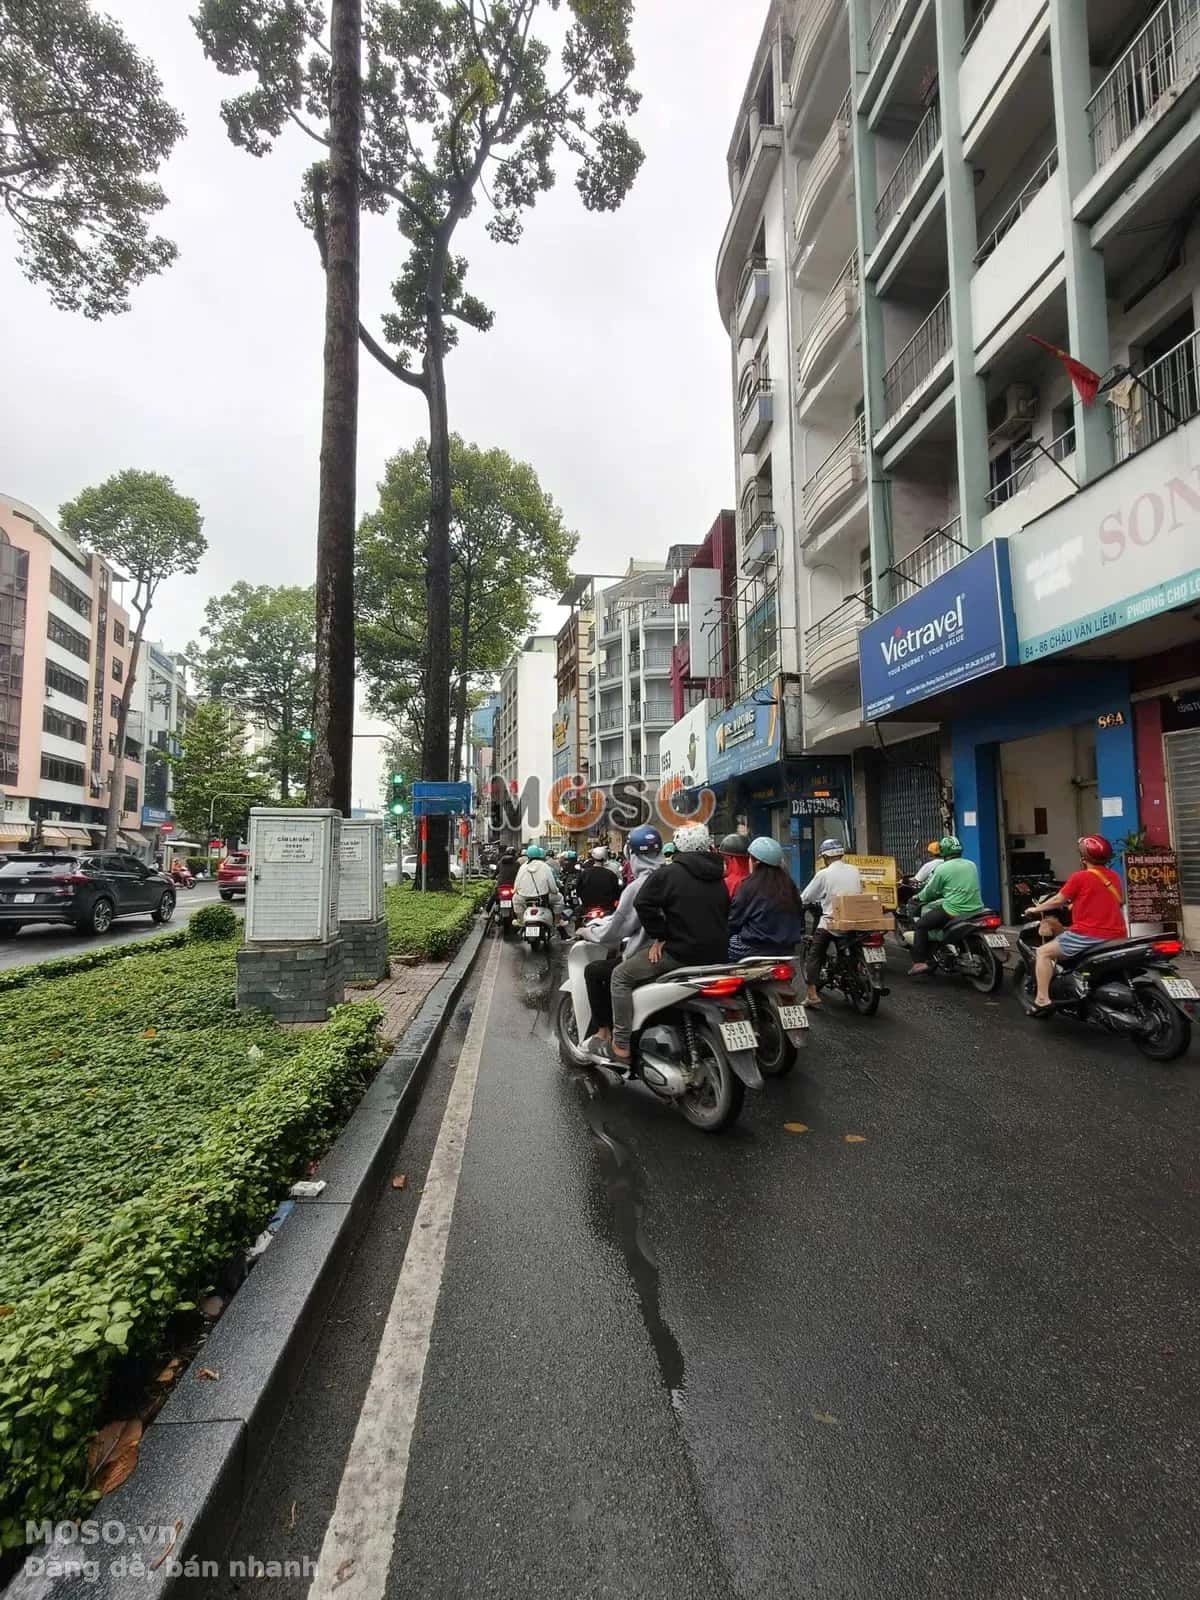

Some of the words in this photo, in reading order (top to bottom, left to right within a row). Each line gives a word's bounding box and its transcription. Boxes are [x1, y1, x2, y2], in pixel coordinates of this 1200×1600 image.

[880, 594, 964, 665] Vietravel
[945, 633, 965, 649] VALUE
[1024, 646, 1034, 659] 84
[1039, 639, 1048, 654] 86
[1049, 629, 1072, 650] CHÂU
[1097, 711, 1124, 729] 86A
